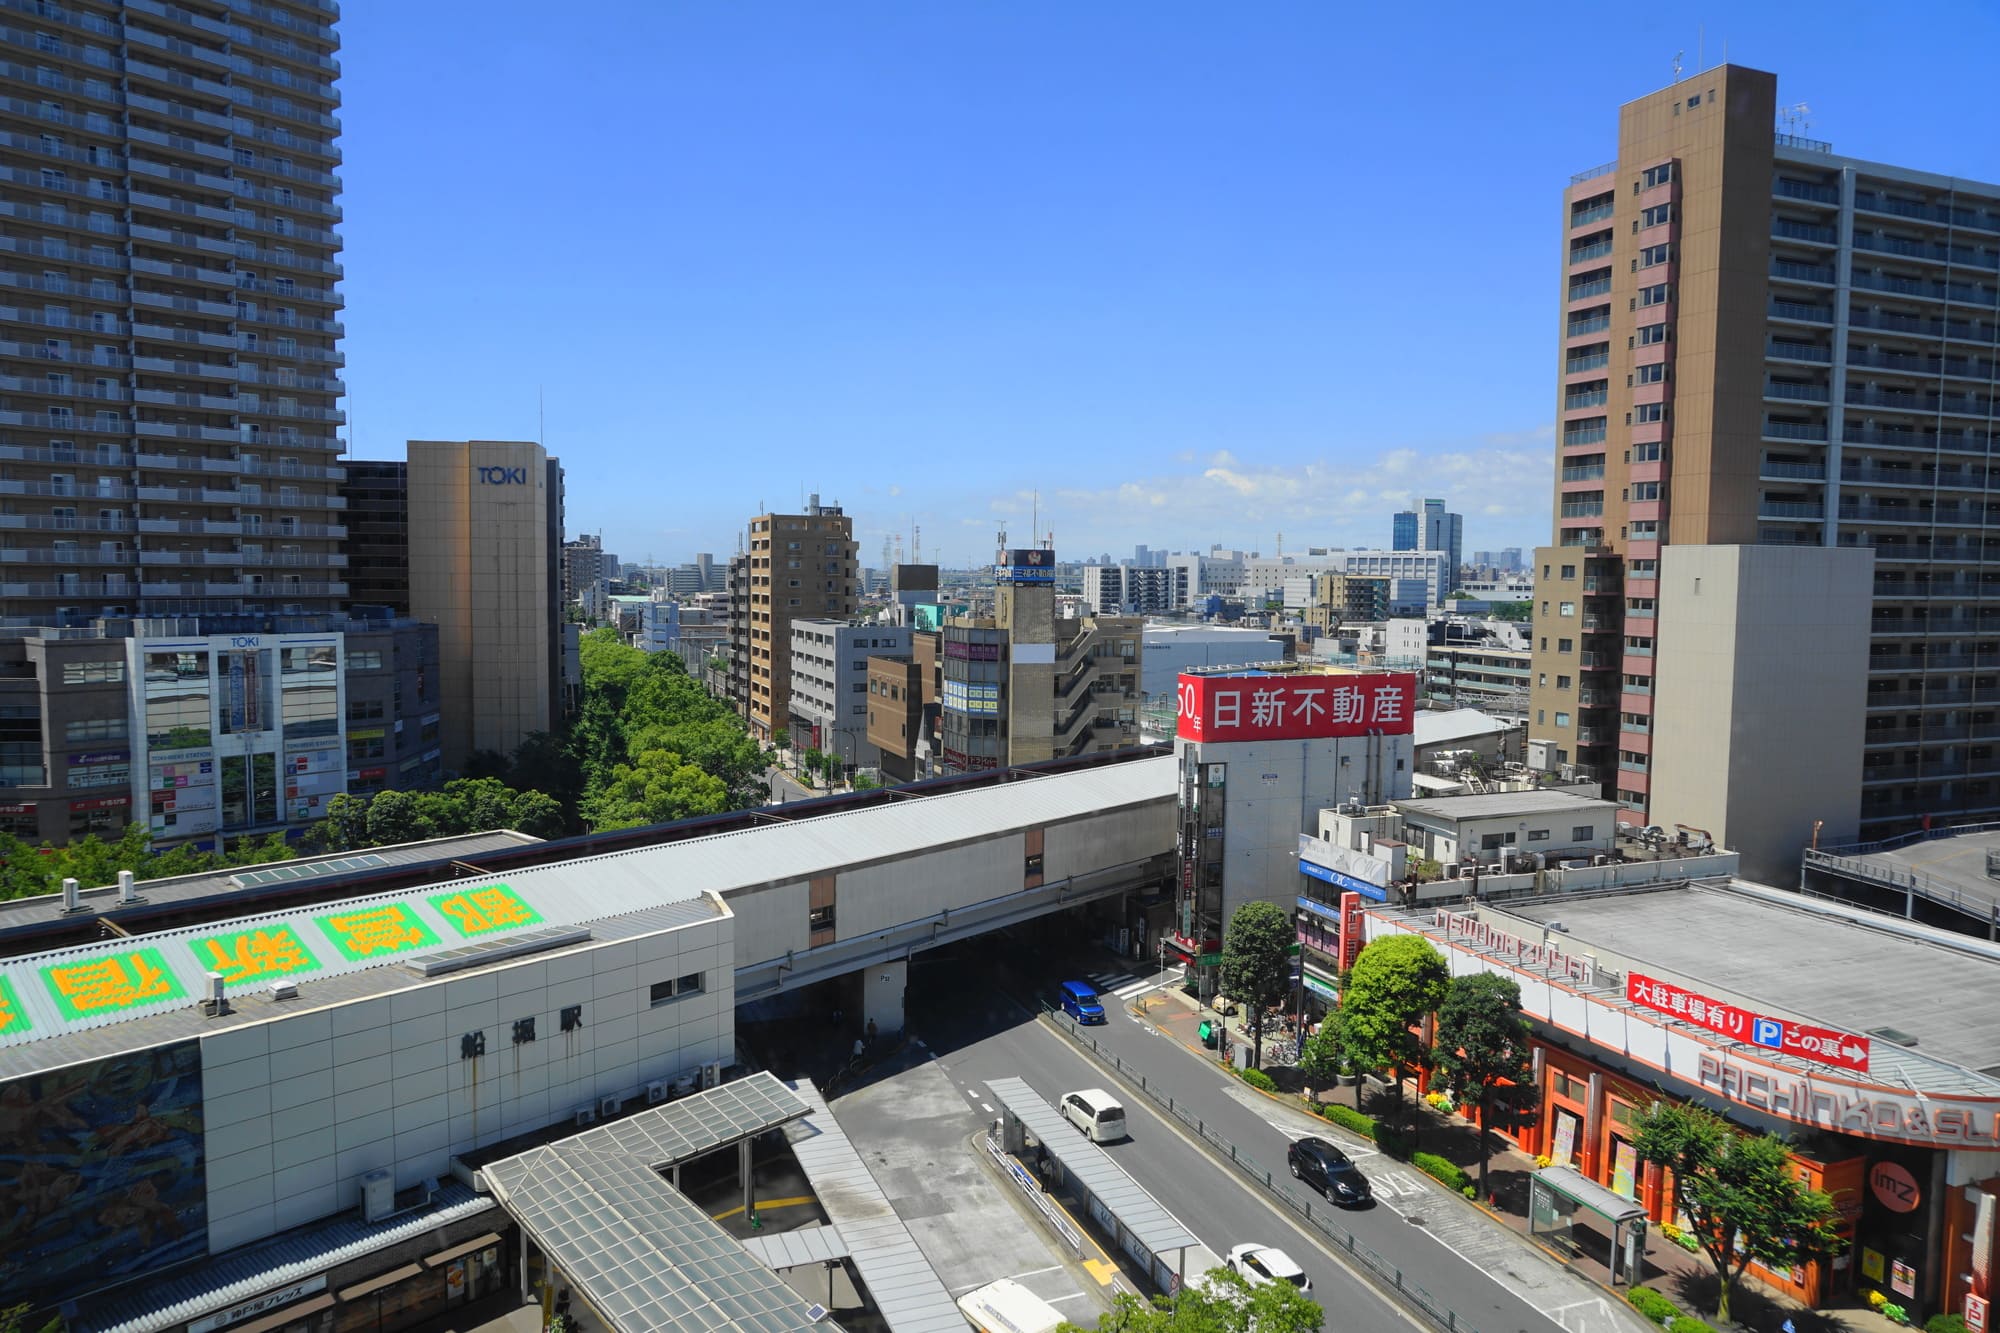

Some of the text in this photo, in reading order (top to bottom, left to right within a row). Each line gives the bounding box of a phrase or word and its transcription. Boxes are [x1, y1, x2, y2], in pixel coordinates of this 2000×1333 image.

[477, 466, 526, 485] TOKI
[231, 637, 259, 648] TOKI
[1214, 684, 1404, 729] 日新不動産
[1634, 979, 1842, 1060] 大駐車場有り P この裏
